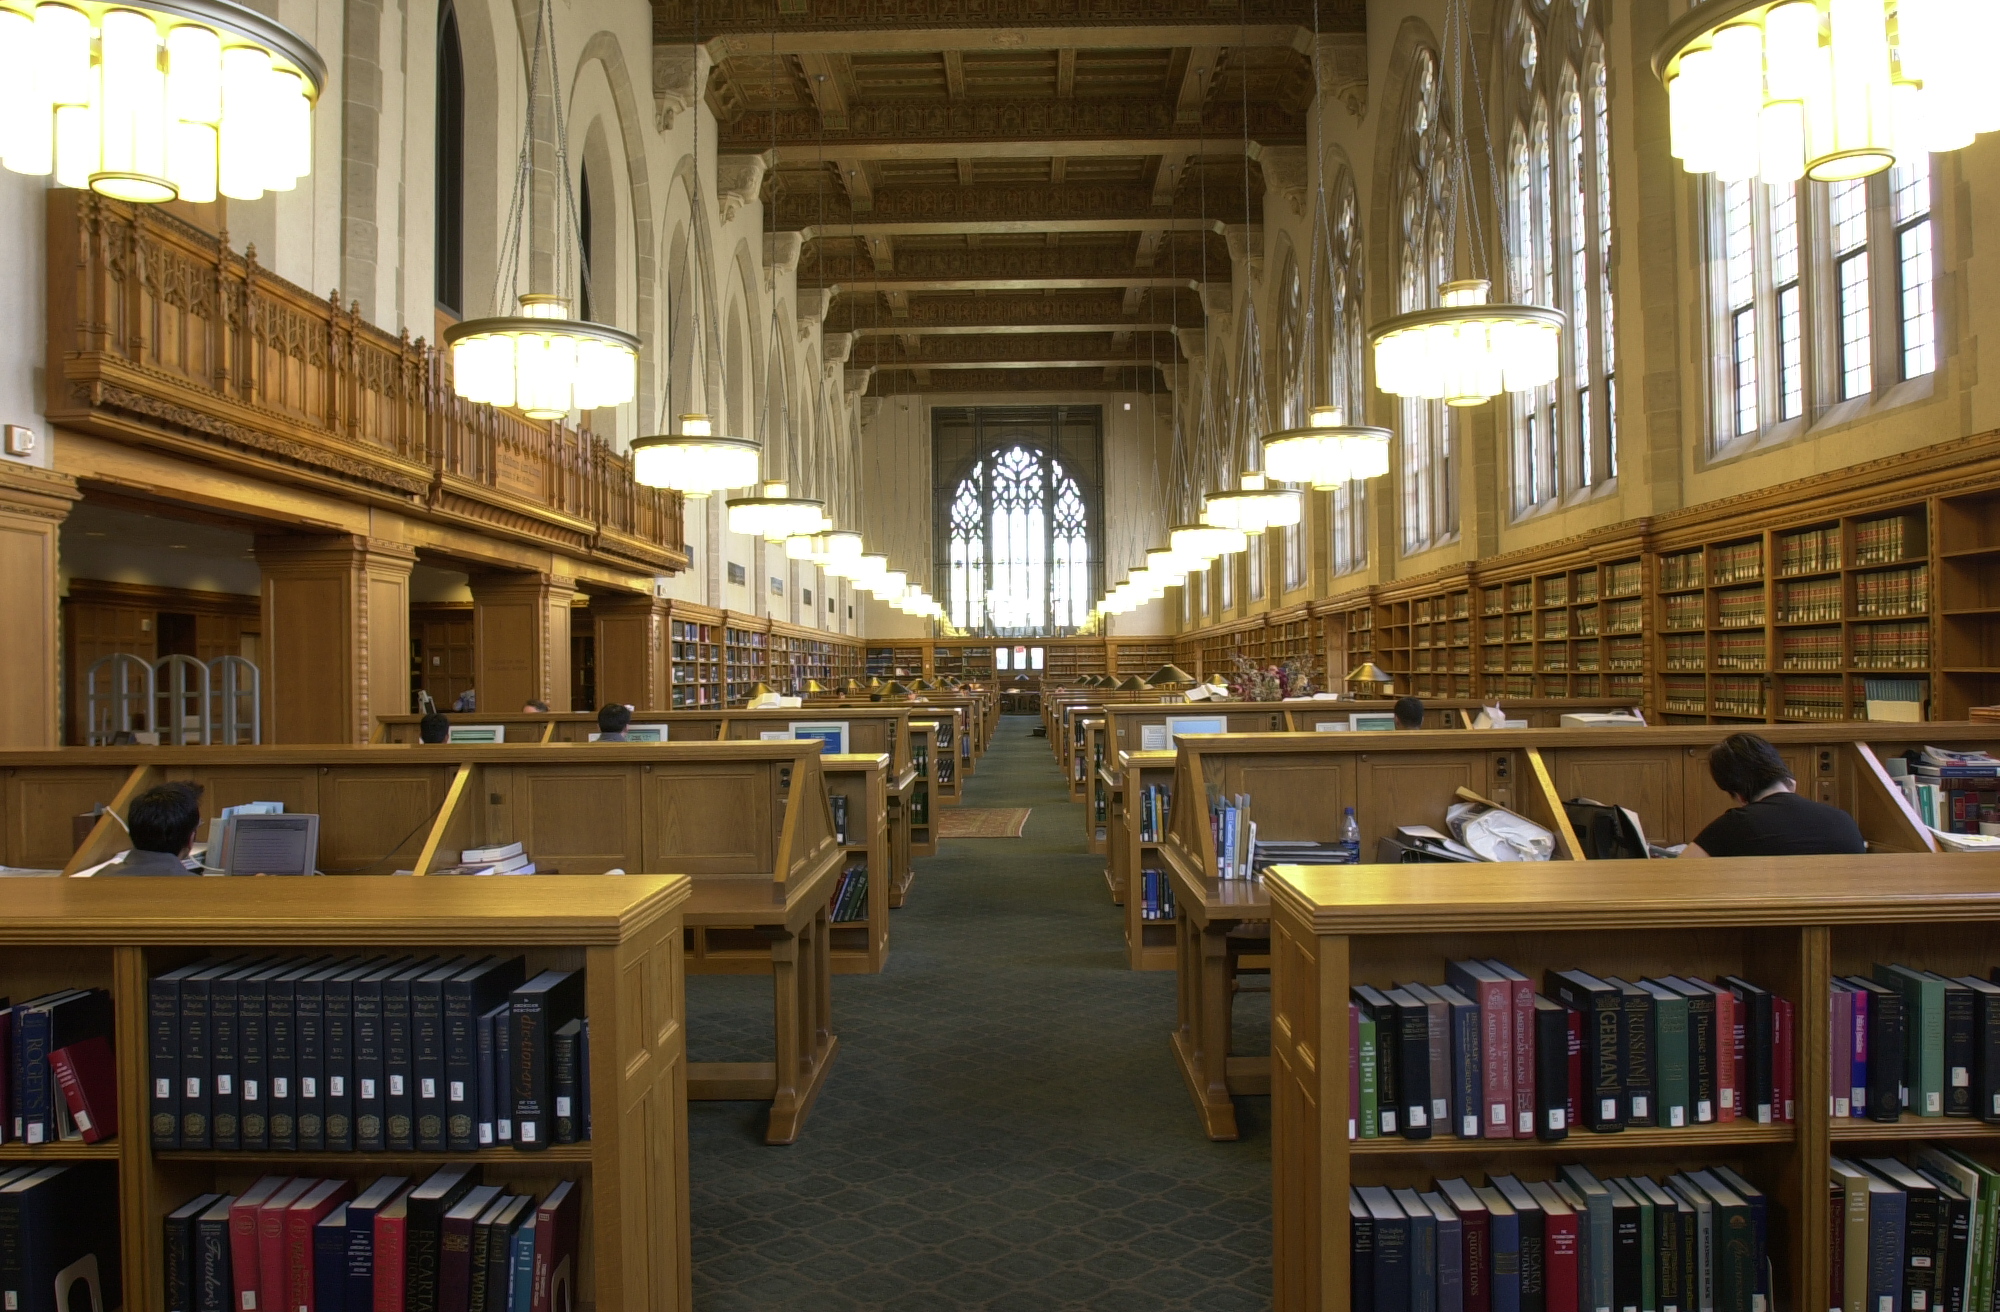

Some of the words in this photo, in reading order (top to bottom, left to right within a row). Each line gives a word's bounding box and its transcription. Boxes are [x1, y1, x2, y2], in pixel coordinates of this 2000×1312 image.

[517, 1014, 536, 1098] dictionary
[1600, 1011, 1618, 1086] GERMAN
[1629, 1014, 1646, 1078] RUSSIAN
[1698, 1016, 1708, 1052] Phrase
[1699, 1056, 1710, 1075] and
[1517, 1057, 1525, 1084] SLANG
[204, 1236, 221, 1307] Fowler's
[407, 1229, 418, 1312] DICTIONARY
[418, 1230, 435, 1312] ENCARTA
[474, 1234, 487, 1267] NEW
[1467, 1231, 1479, 1296] QUOTATIONS
[1531, 1238, 1542, 1294] ENCARTA
